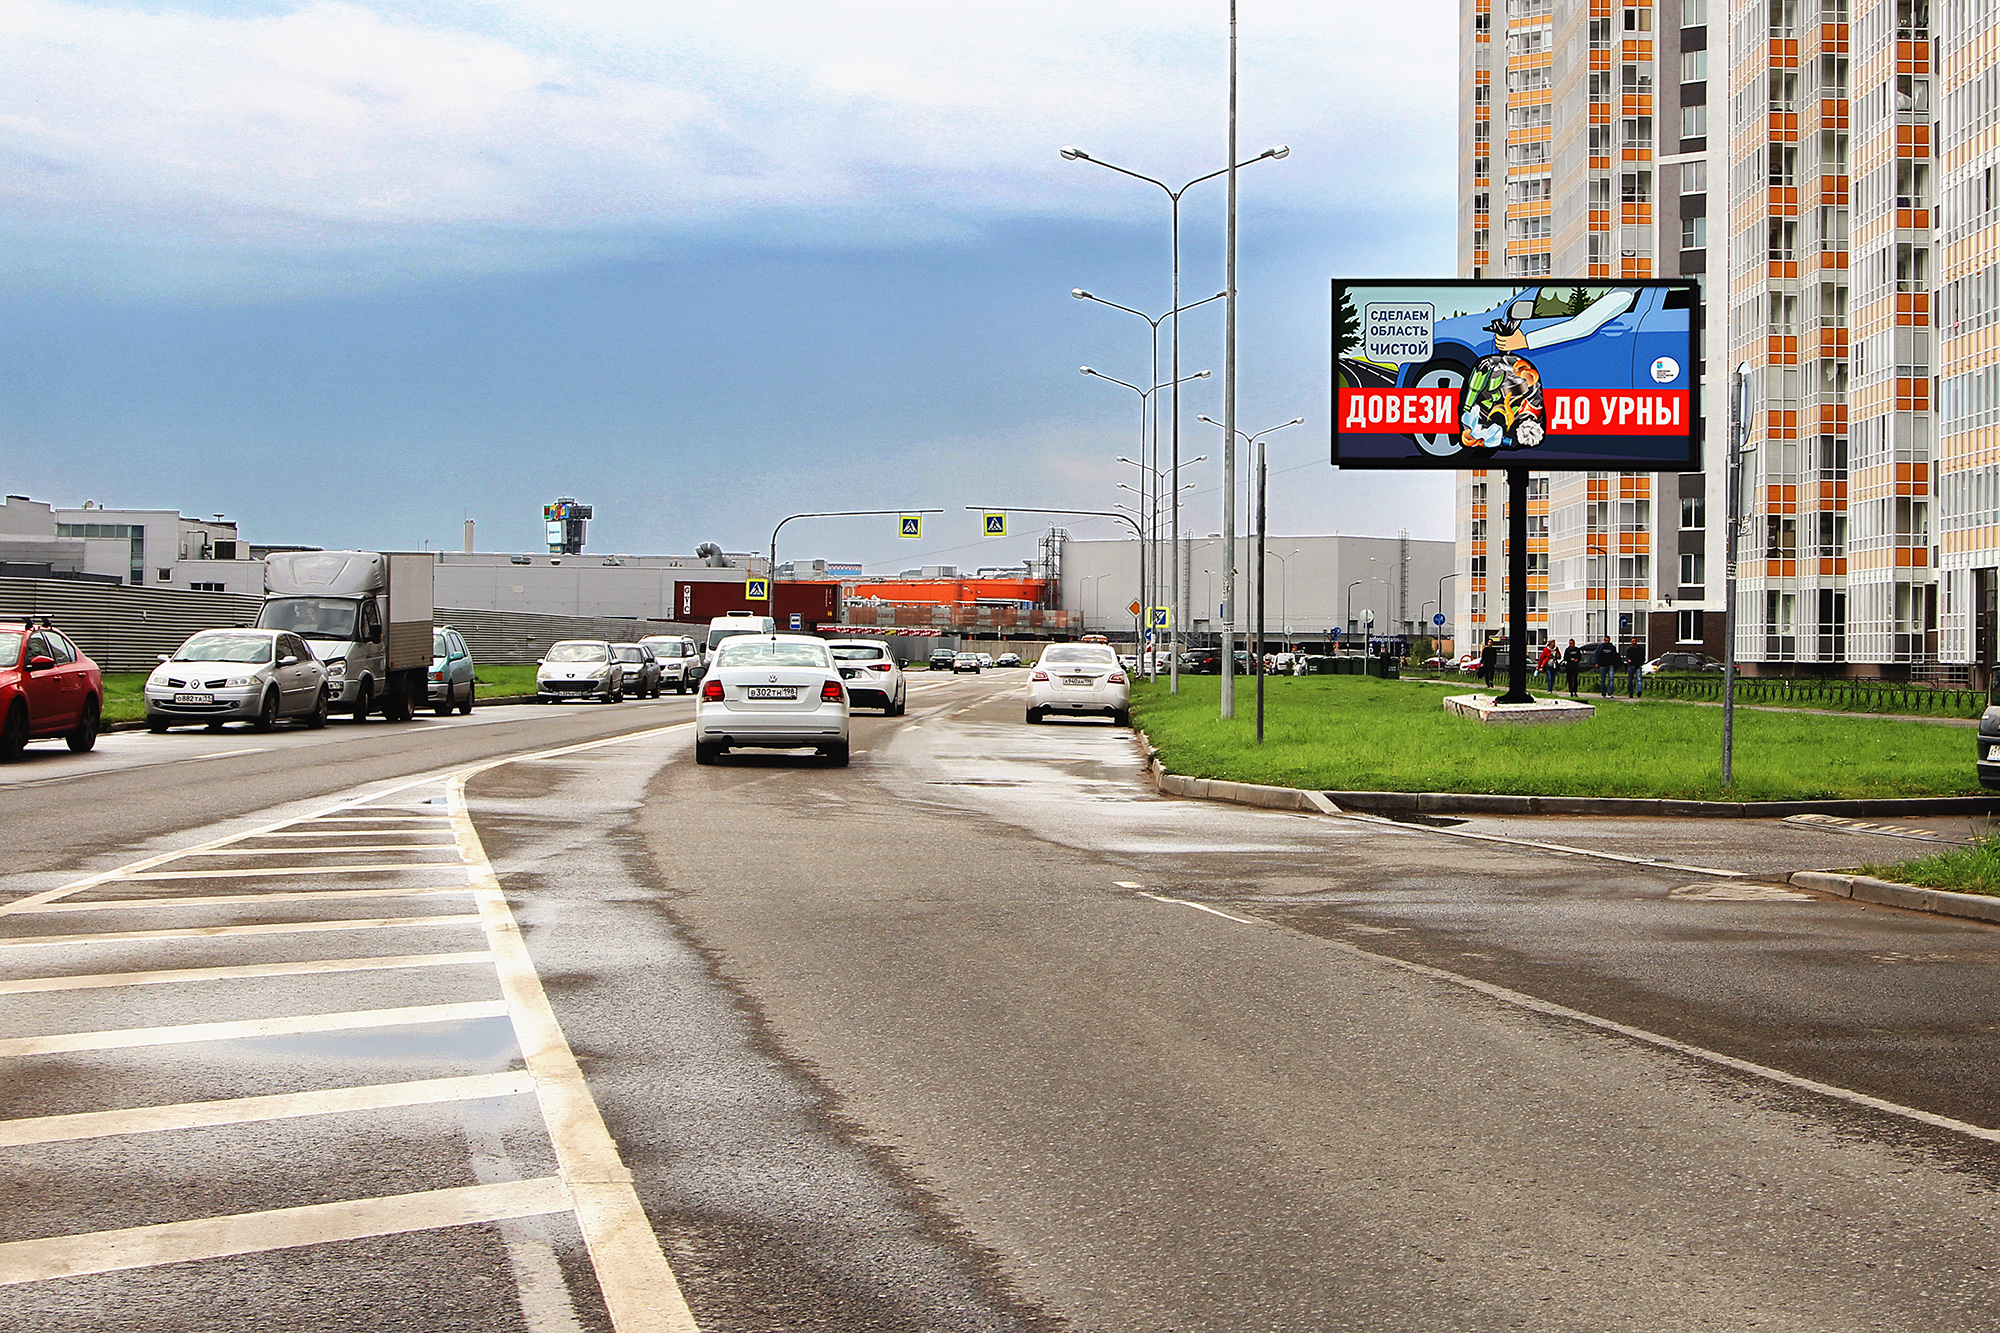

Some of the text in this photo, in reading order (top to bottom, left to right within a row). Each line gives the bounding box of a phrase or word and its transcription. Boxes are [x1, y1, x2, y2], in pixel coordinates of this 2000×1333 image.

[1370, 310, 1429, 322] СДЕЛАЕМ
[1370, 326, 1429, 336] ОБЛАСТЬ
[1370, 340, 1428, 355] ЧИСТОЙ
[1346, 395, 1452, 428] ДОВЕЗИ
[1551, 396, 1680, 430] ДО УРНЫ
